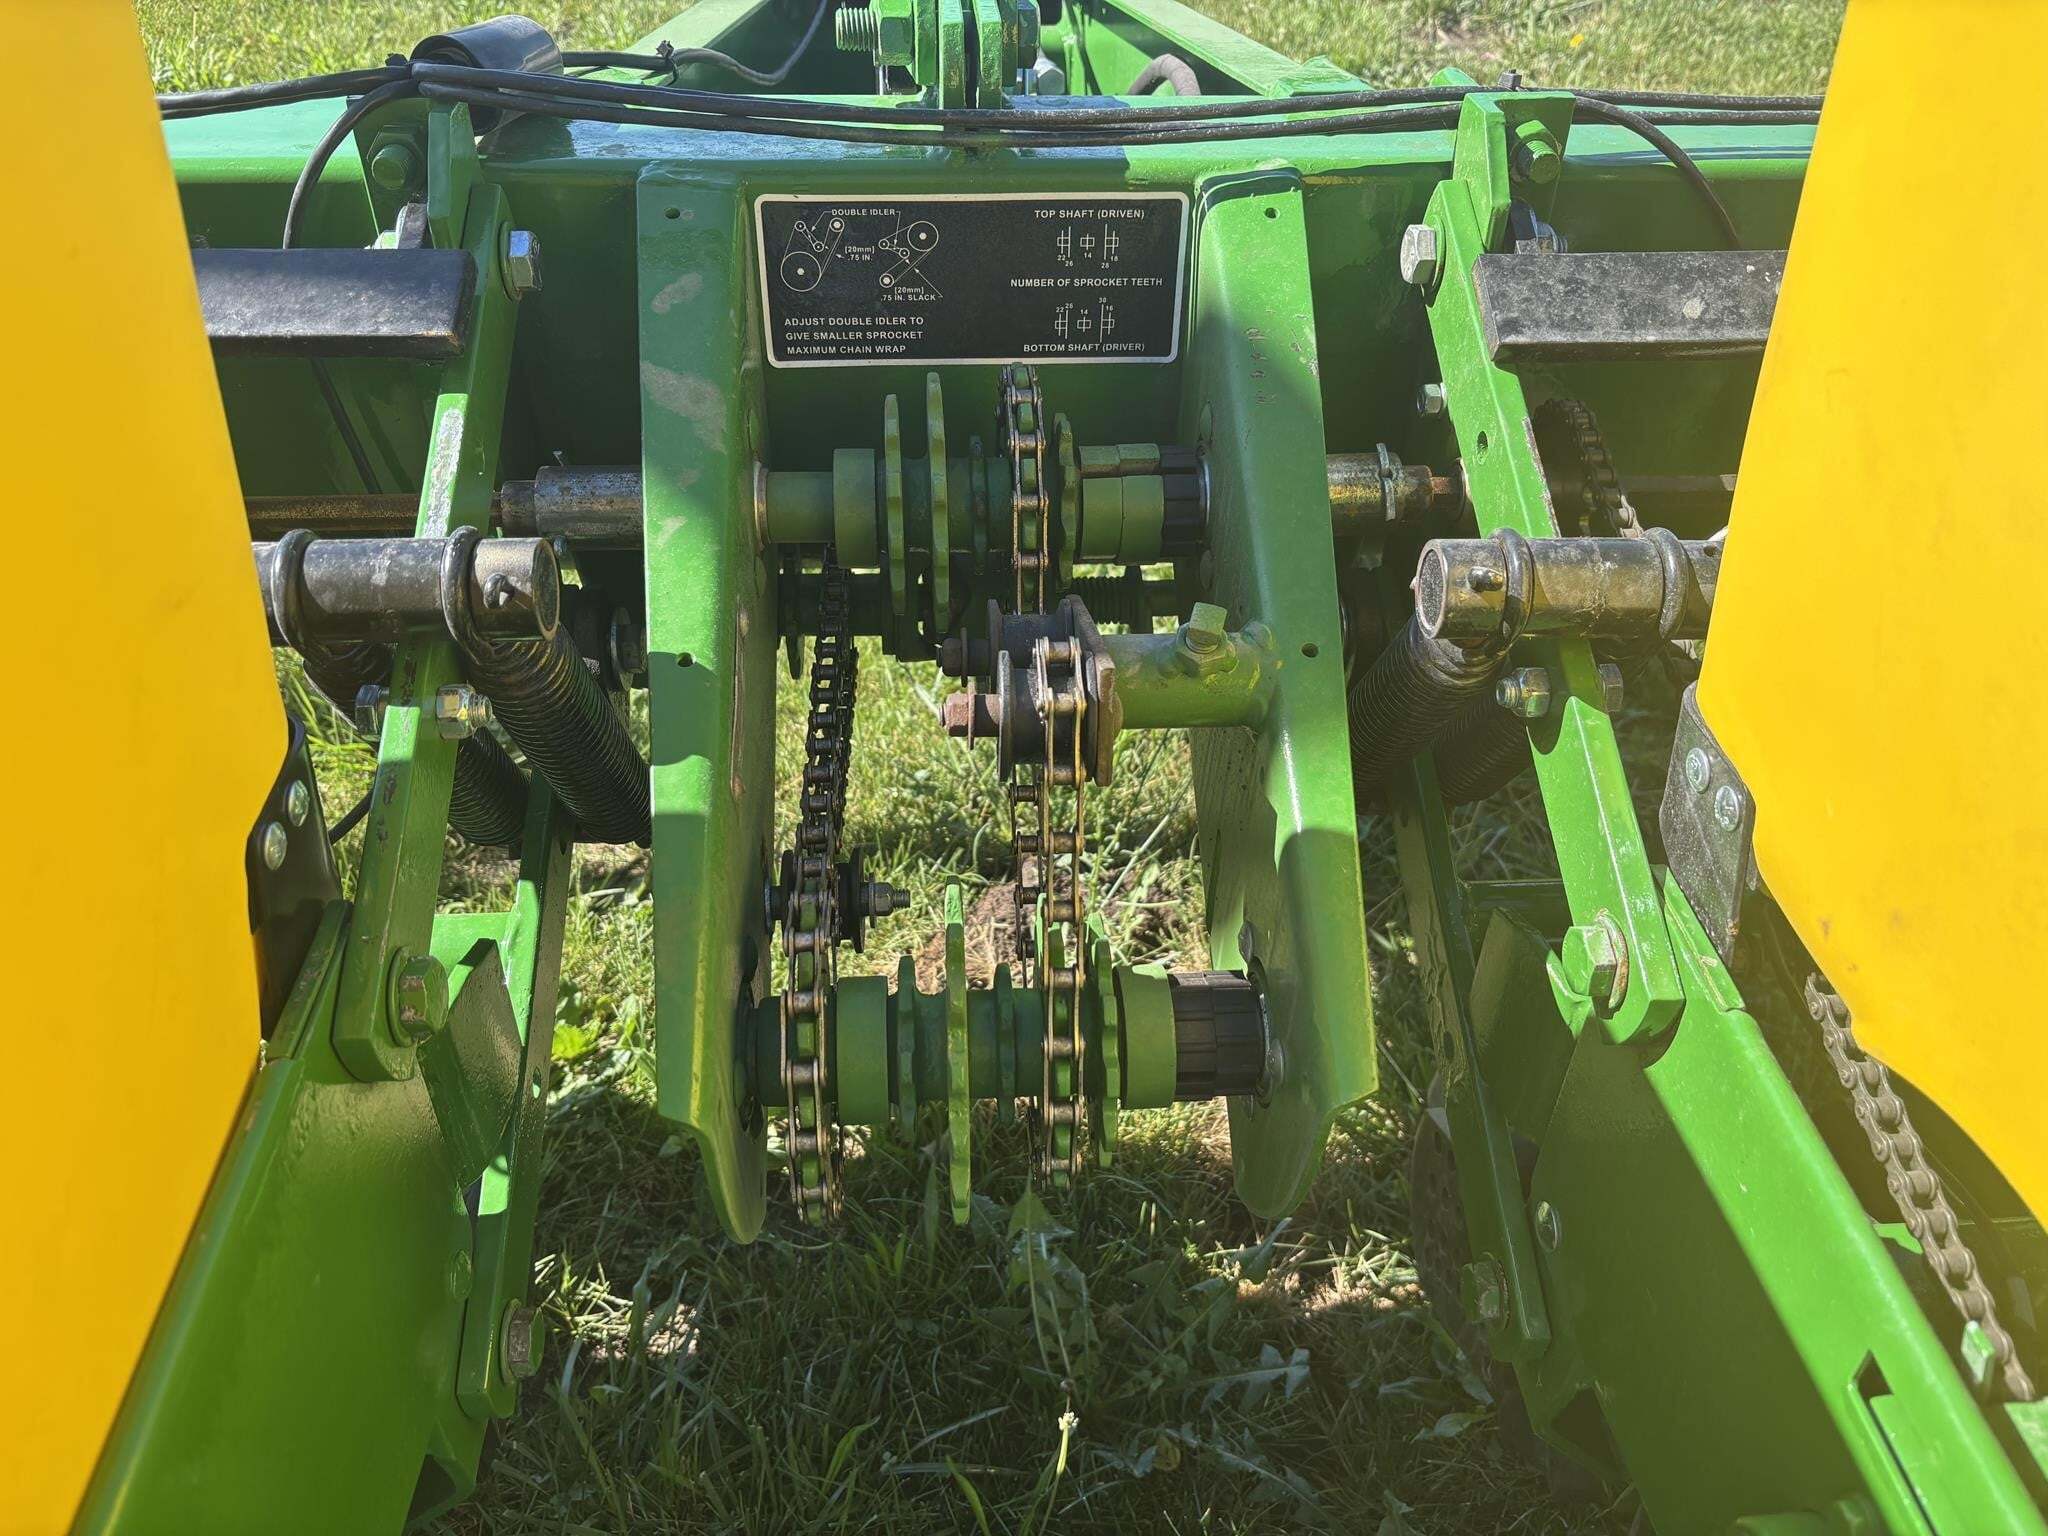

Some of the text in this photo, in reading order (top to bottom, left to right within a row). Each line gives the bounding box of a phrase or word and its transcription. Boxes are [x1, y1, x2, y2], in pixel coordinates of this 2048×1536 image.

[831, 208, 896, 216] DOUBLE IDLER
[1034, 209, 1145, 220] TOP SHAFT (DRIVEN)
[1010, 277, 1163, 287] NUMBER OF SPROCKET TEETH
[784, 316, 924, 326] ADJUST DOUBLE IDLER TO
[785, 331, 924, 341] GIVE SMALLER SPROCKET
[787, 345, 906, 355] MAXIMUM CHAIN WRAP
[1023, 343, 1145, 353] BOTTOM SHAFT (DRIVER)
